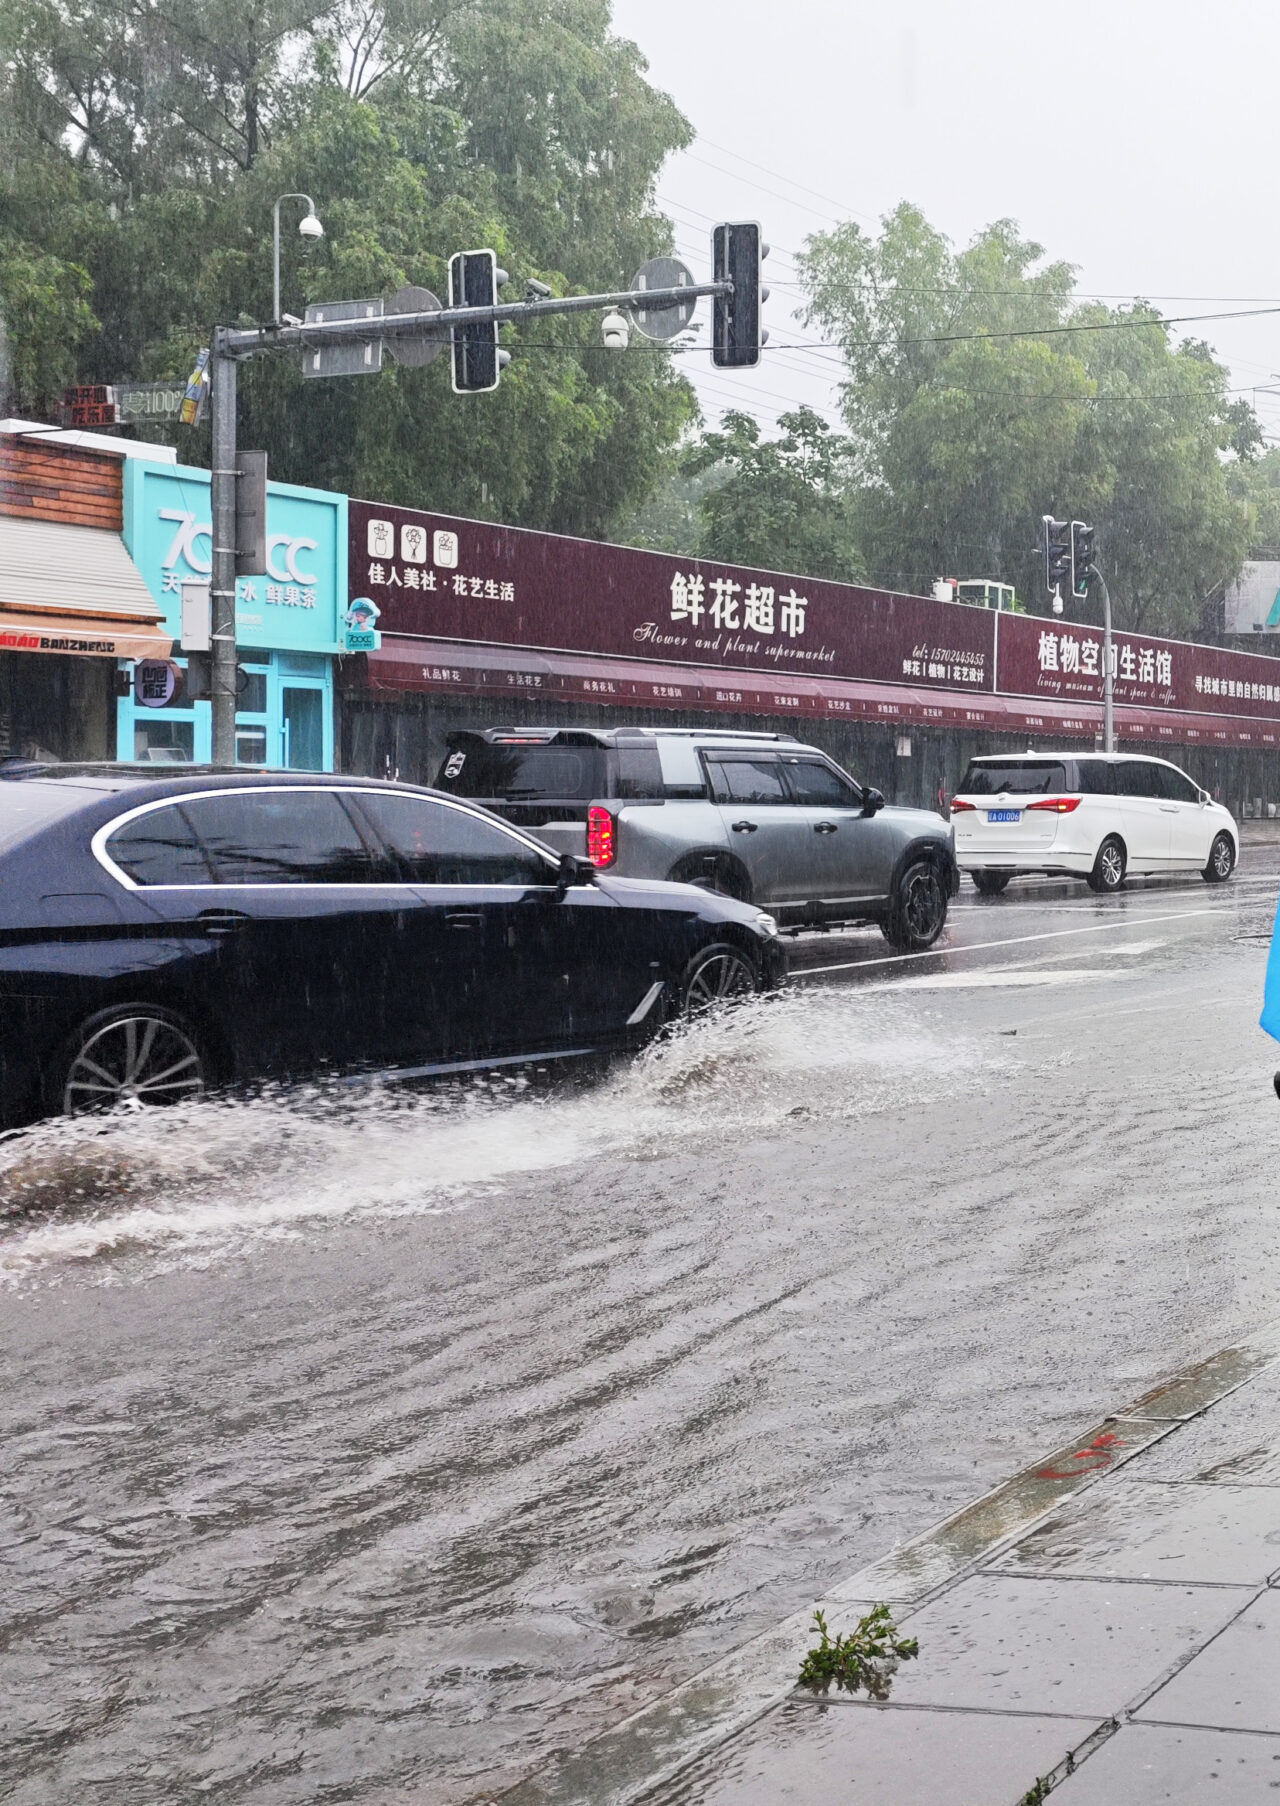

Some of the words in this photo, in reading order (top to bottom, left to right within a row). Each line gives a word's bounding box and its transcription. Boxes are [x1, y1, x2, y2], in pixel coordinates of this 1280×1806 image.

[266, 584, 317, 608] 鲜果茶
[670, 571, 809, 638] 鲜花超市
[40, 637, 116, 653] BANZHENG
[633, 622, 688, 646] Flower
[695, 633, 722, 650] and
[723, 635, 760, 657] plant
[765, 644, 836, 662] supermarket
[912, 643, 928, 659] tel:
[422, 667, 462, 682] 礼品鲜花
[1037, 673, 1062, 694] living
[1065, 683, 1094, 692] museum
